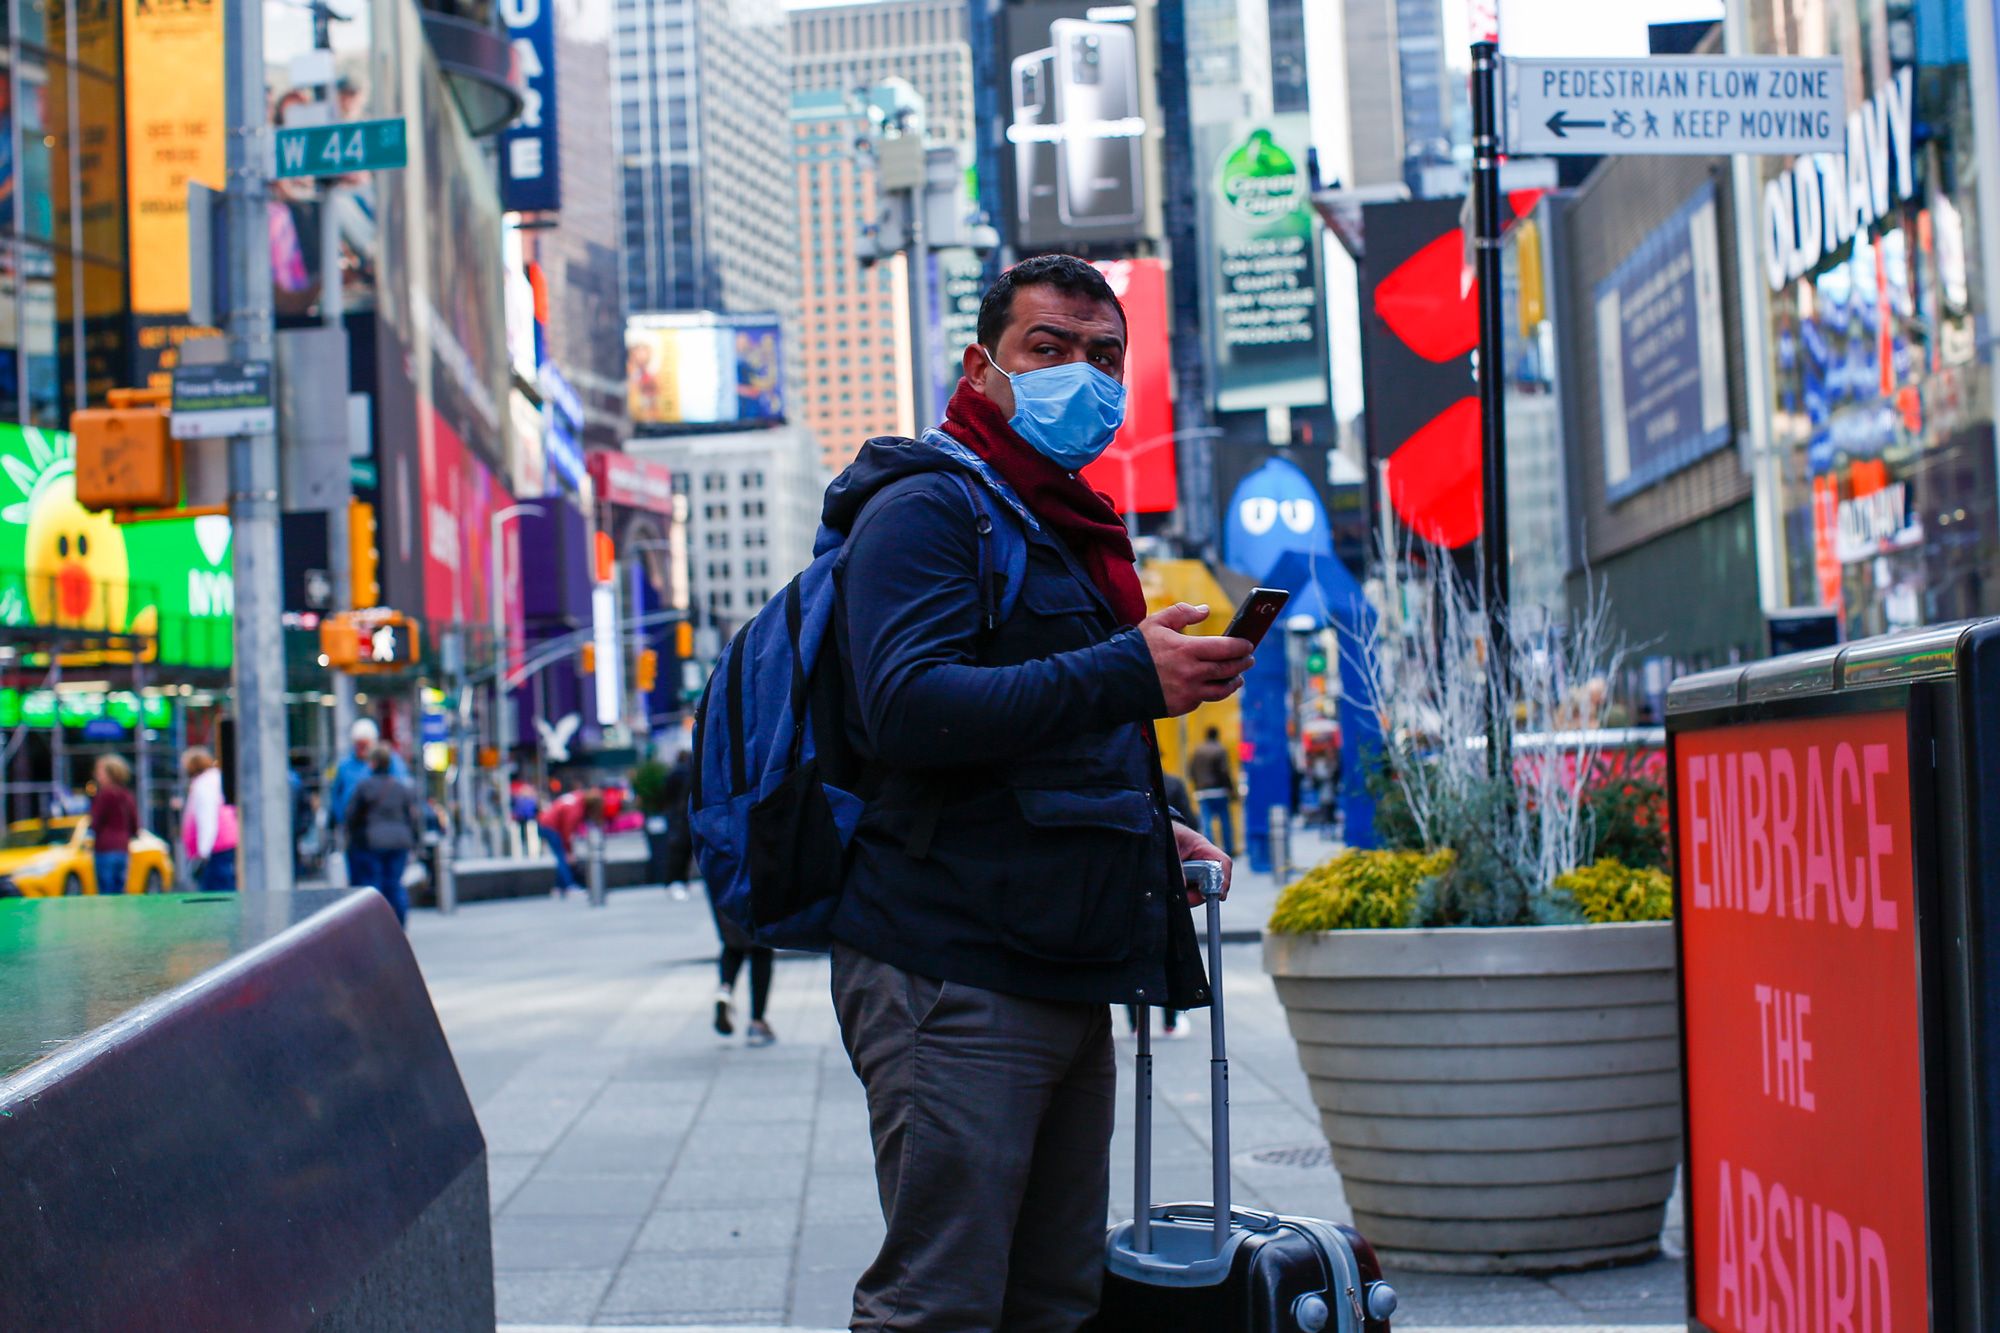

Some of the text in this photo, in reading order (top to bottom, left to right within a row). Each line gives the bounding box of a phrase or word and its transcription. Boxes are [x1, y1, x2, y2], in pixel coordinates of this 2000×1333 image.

[1542, 70, 1830, 98] PEDESTRIAN FLOW ZONE
[1673, 109, 1831, 139] KEEP MOVING
[281, 134, 306, 170] W
[321, 128, 365, 164] 44
[1227, 174, 1298, 196] Green
[1764, 153, 1822, 292] OLD
[1816, 65, 1914, 254] NAVY
[1688, 742, 1899, 932] EMBRACE
[1755, 983, 1816, 1113] THE
[1717, 1159, 1893, 1333] ABSURD
